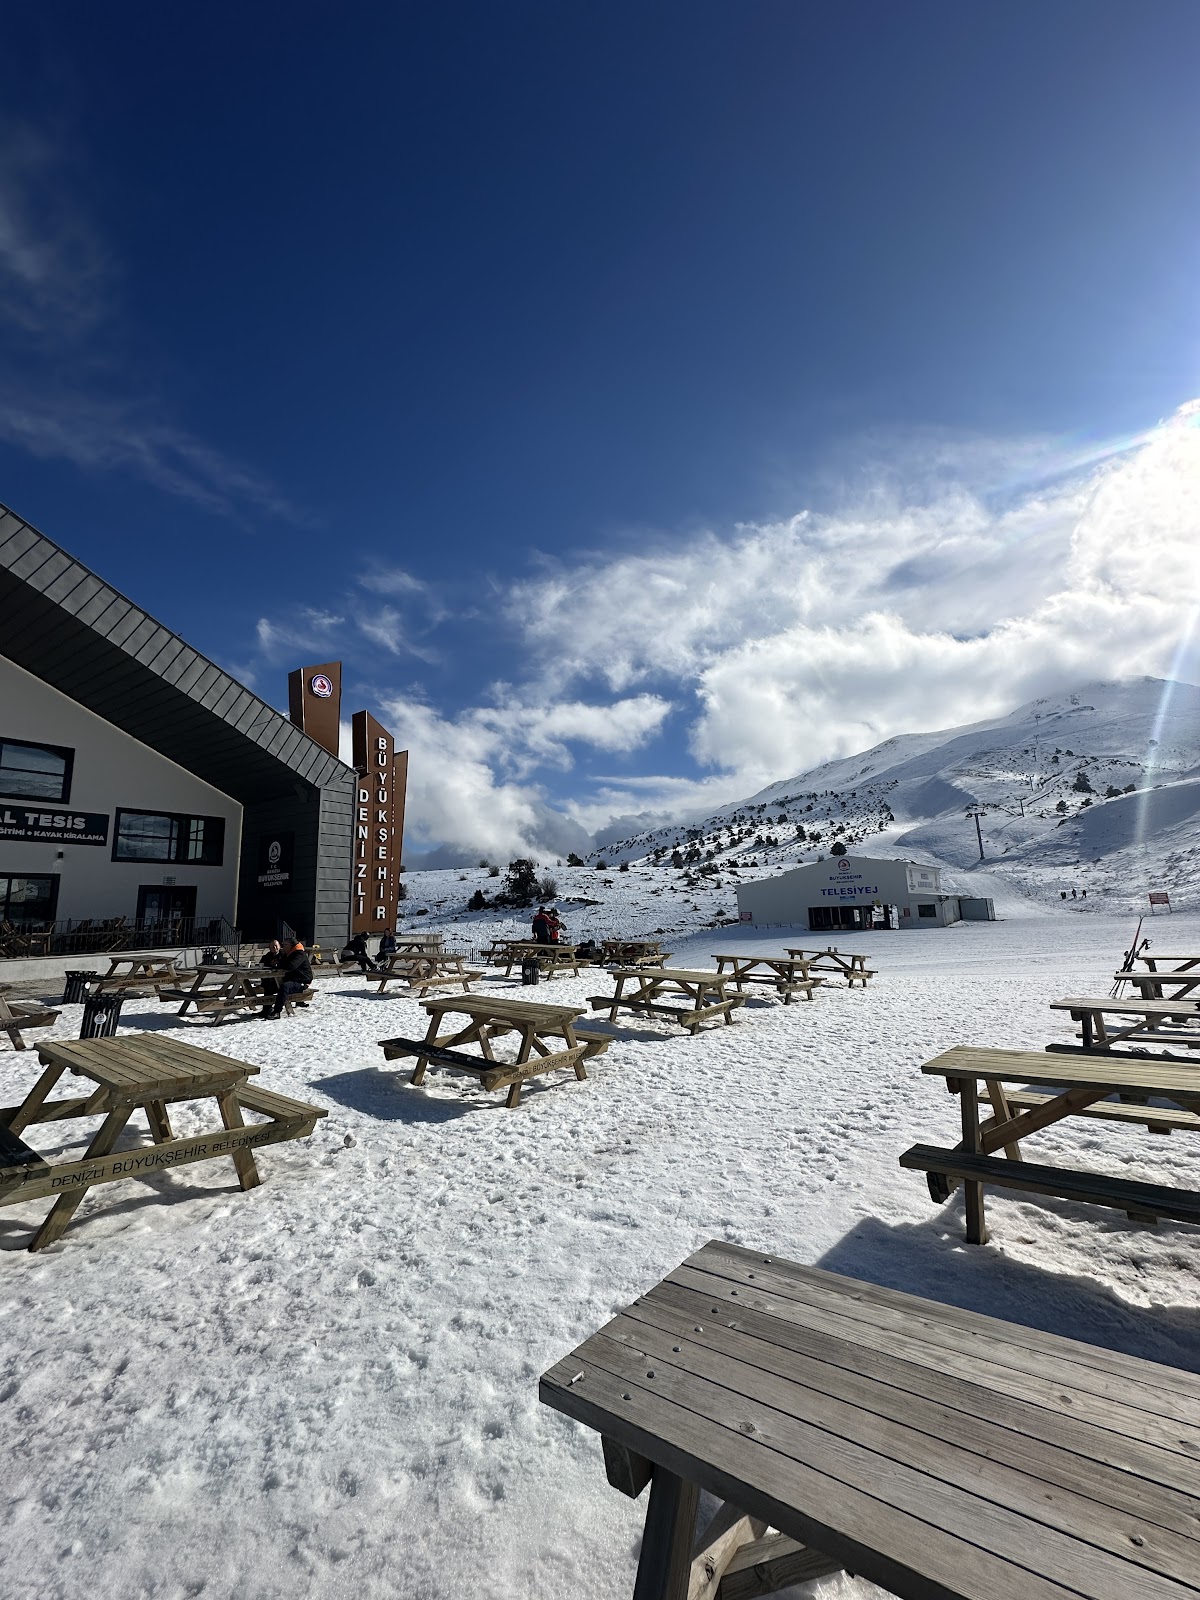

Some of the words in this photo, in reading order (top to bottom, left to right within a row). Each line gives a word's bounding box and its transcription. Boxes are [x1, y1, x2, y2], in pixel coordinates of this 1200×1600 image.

[0, 811, 17, 824] L
[376, 737, 388, 919] BÜYÜKŞEHİR
[34, 831, 62, 839] KAYAK
[63, 832, 105, 841] KİRALAMA
[357, 789, 369, 914] DENİZLİ
[820, 885, 879, 896] TELESİYEJ
[112, 1144, 207, 1176] BÜYÜKŞEHİR
[212, 1131, 271, 1152] BELEDİYESİ
